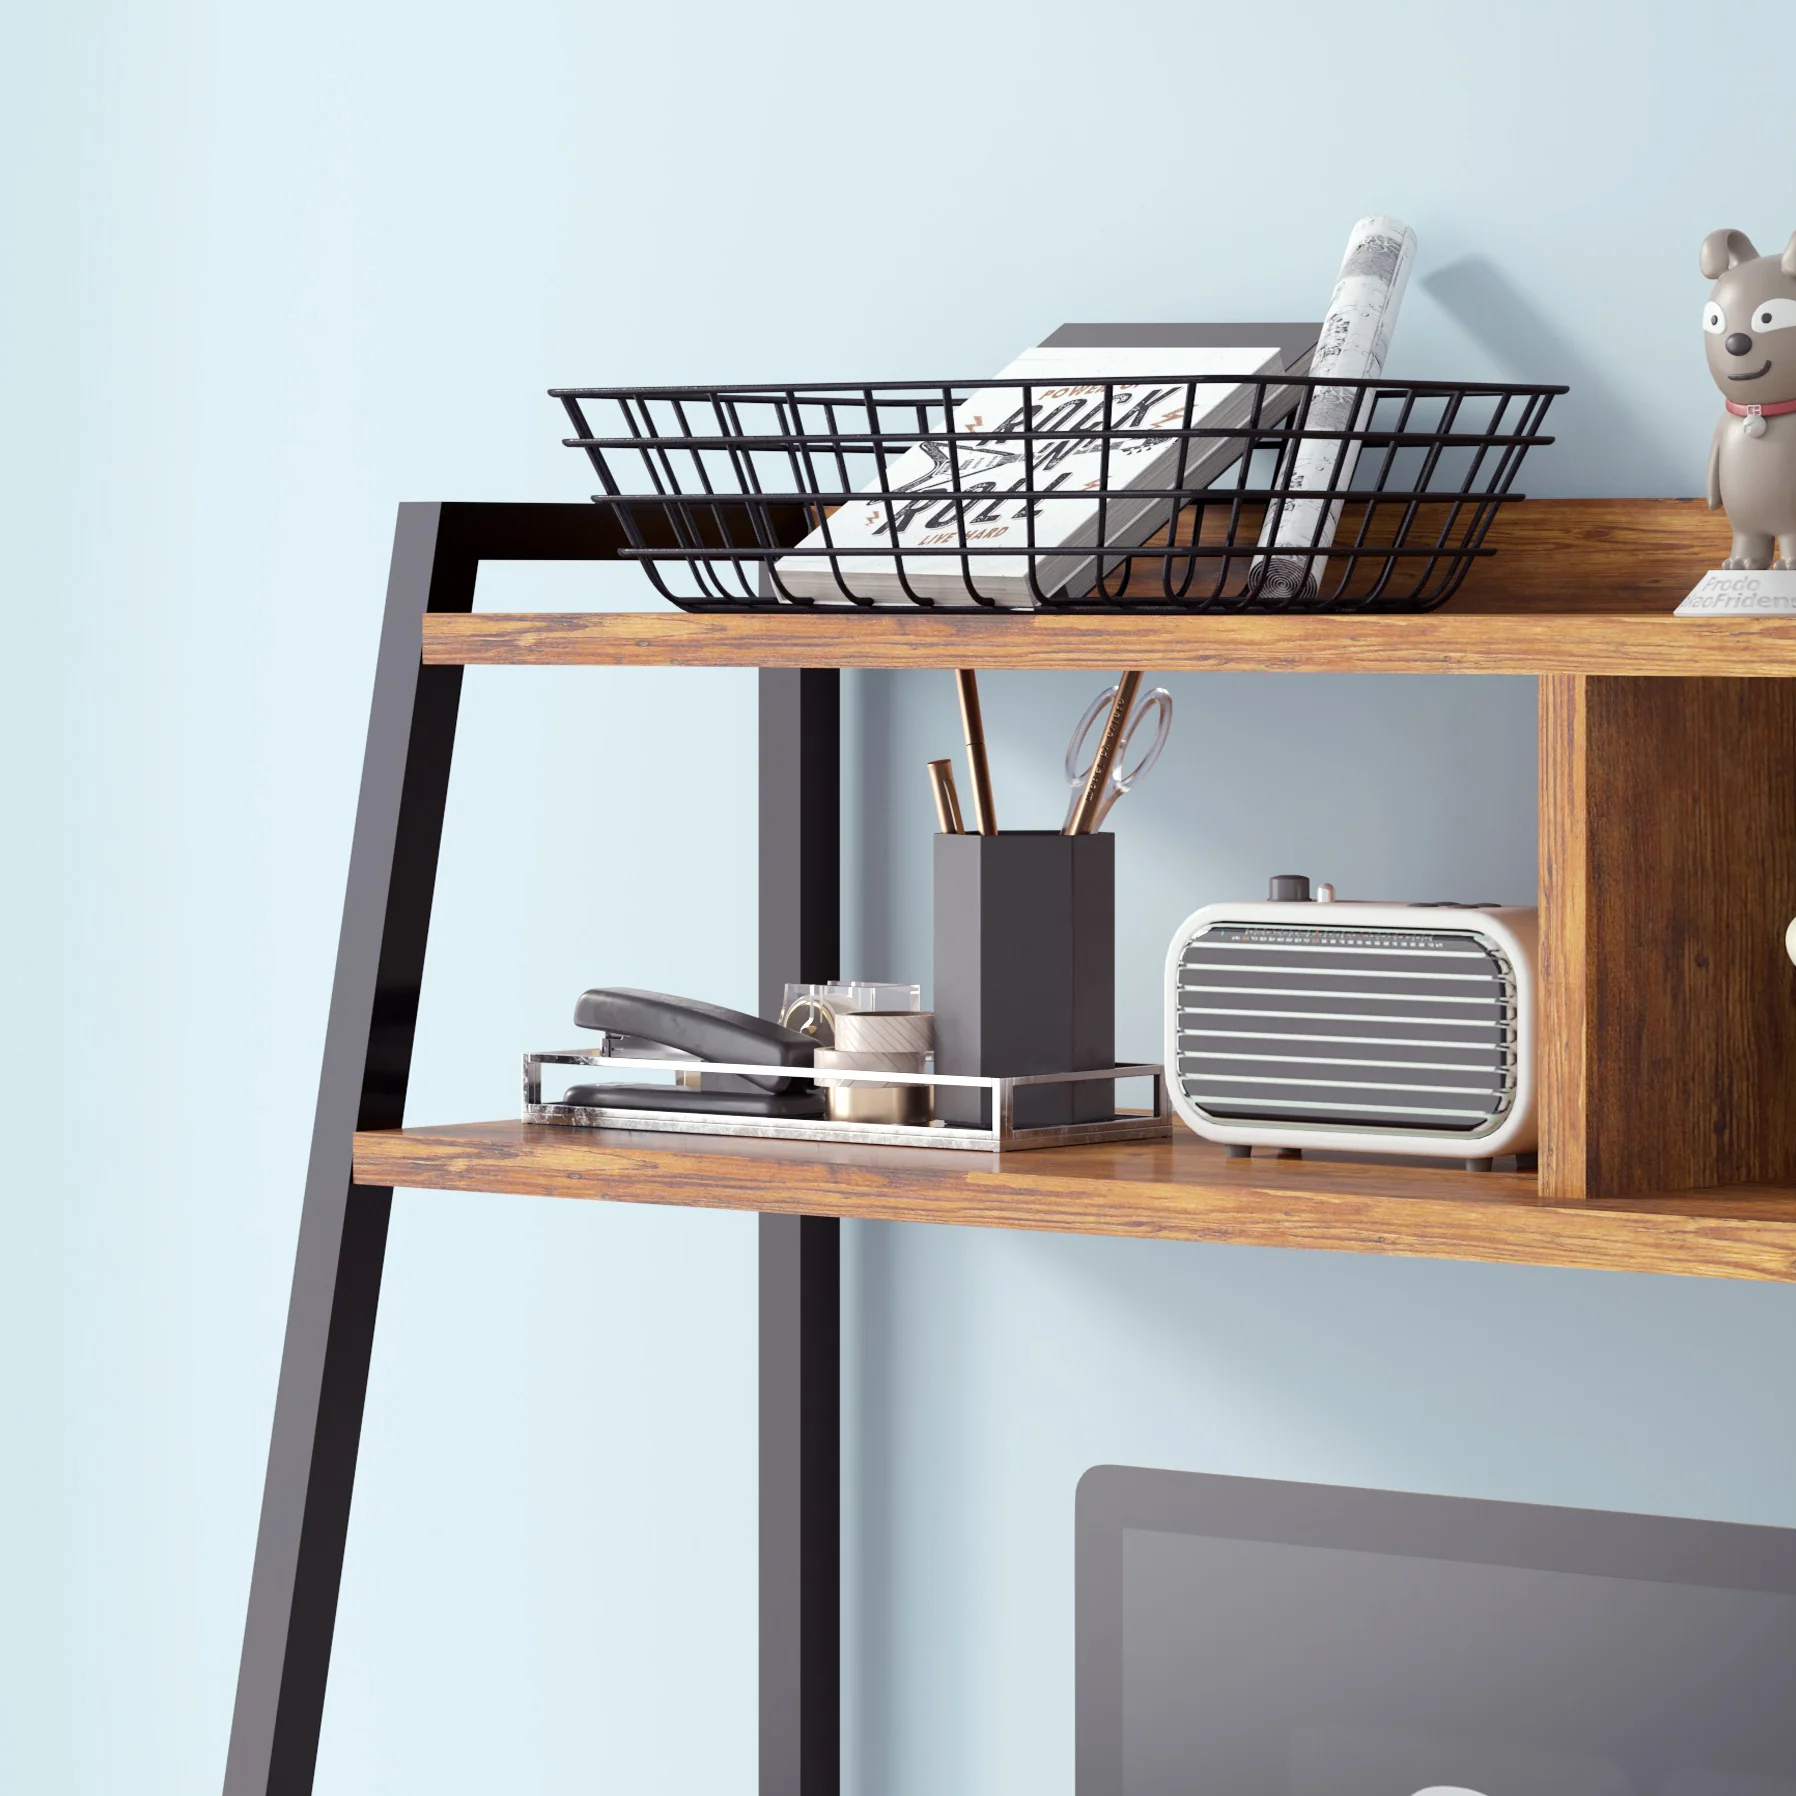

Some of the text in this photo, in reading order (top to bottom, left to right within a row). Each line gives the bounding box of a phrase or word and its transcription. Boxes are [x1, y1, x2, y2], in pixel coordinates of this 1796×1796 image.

[977, 386, 1184, 446] ROCK
[872, 472, 1073, 536] ROLL
[1702, 576, 1761, 591] Frodo
